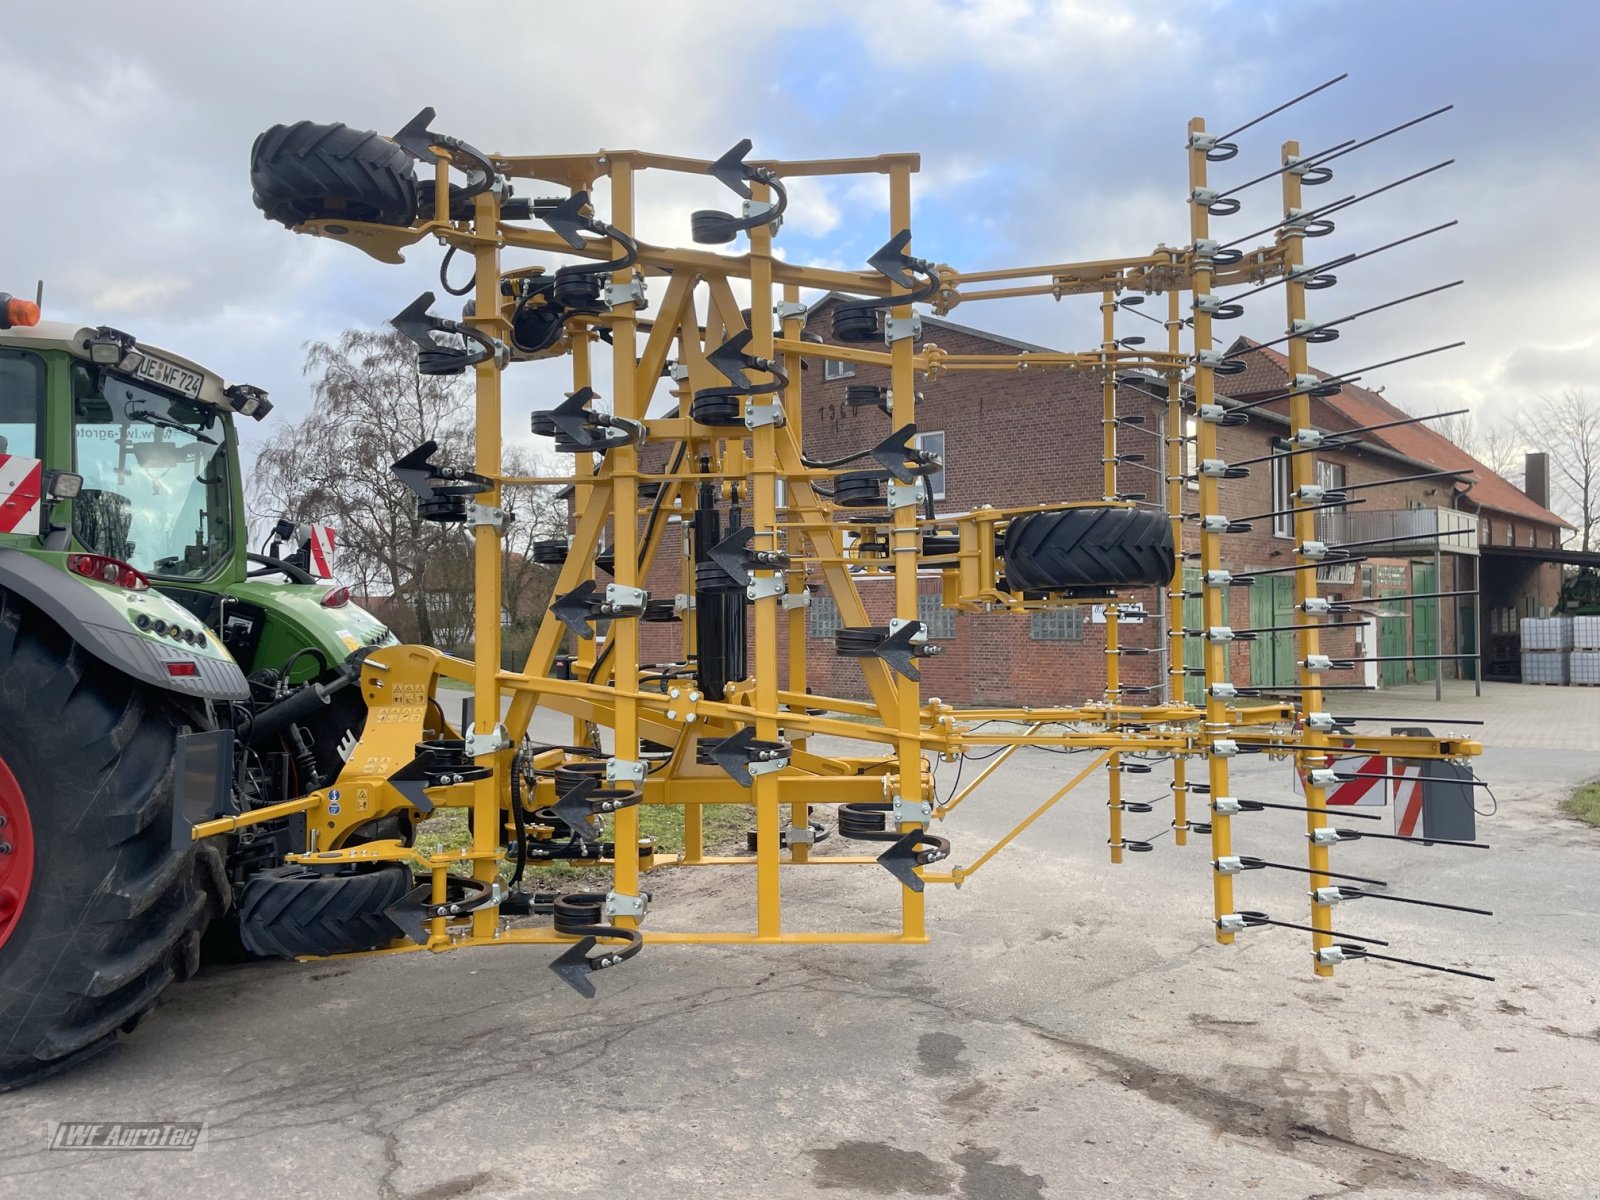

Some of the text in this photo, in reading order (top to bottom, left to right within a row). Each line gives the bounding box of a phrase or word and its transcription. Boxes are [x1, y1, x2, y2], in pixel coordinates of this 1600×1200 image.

[140, 359, 200, 393] UE WF 724
